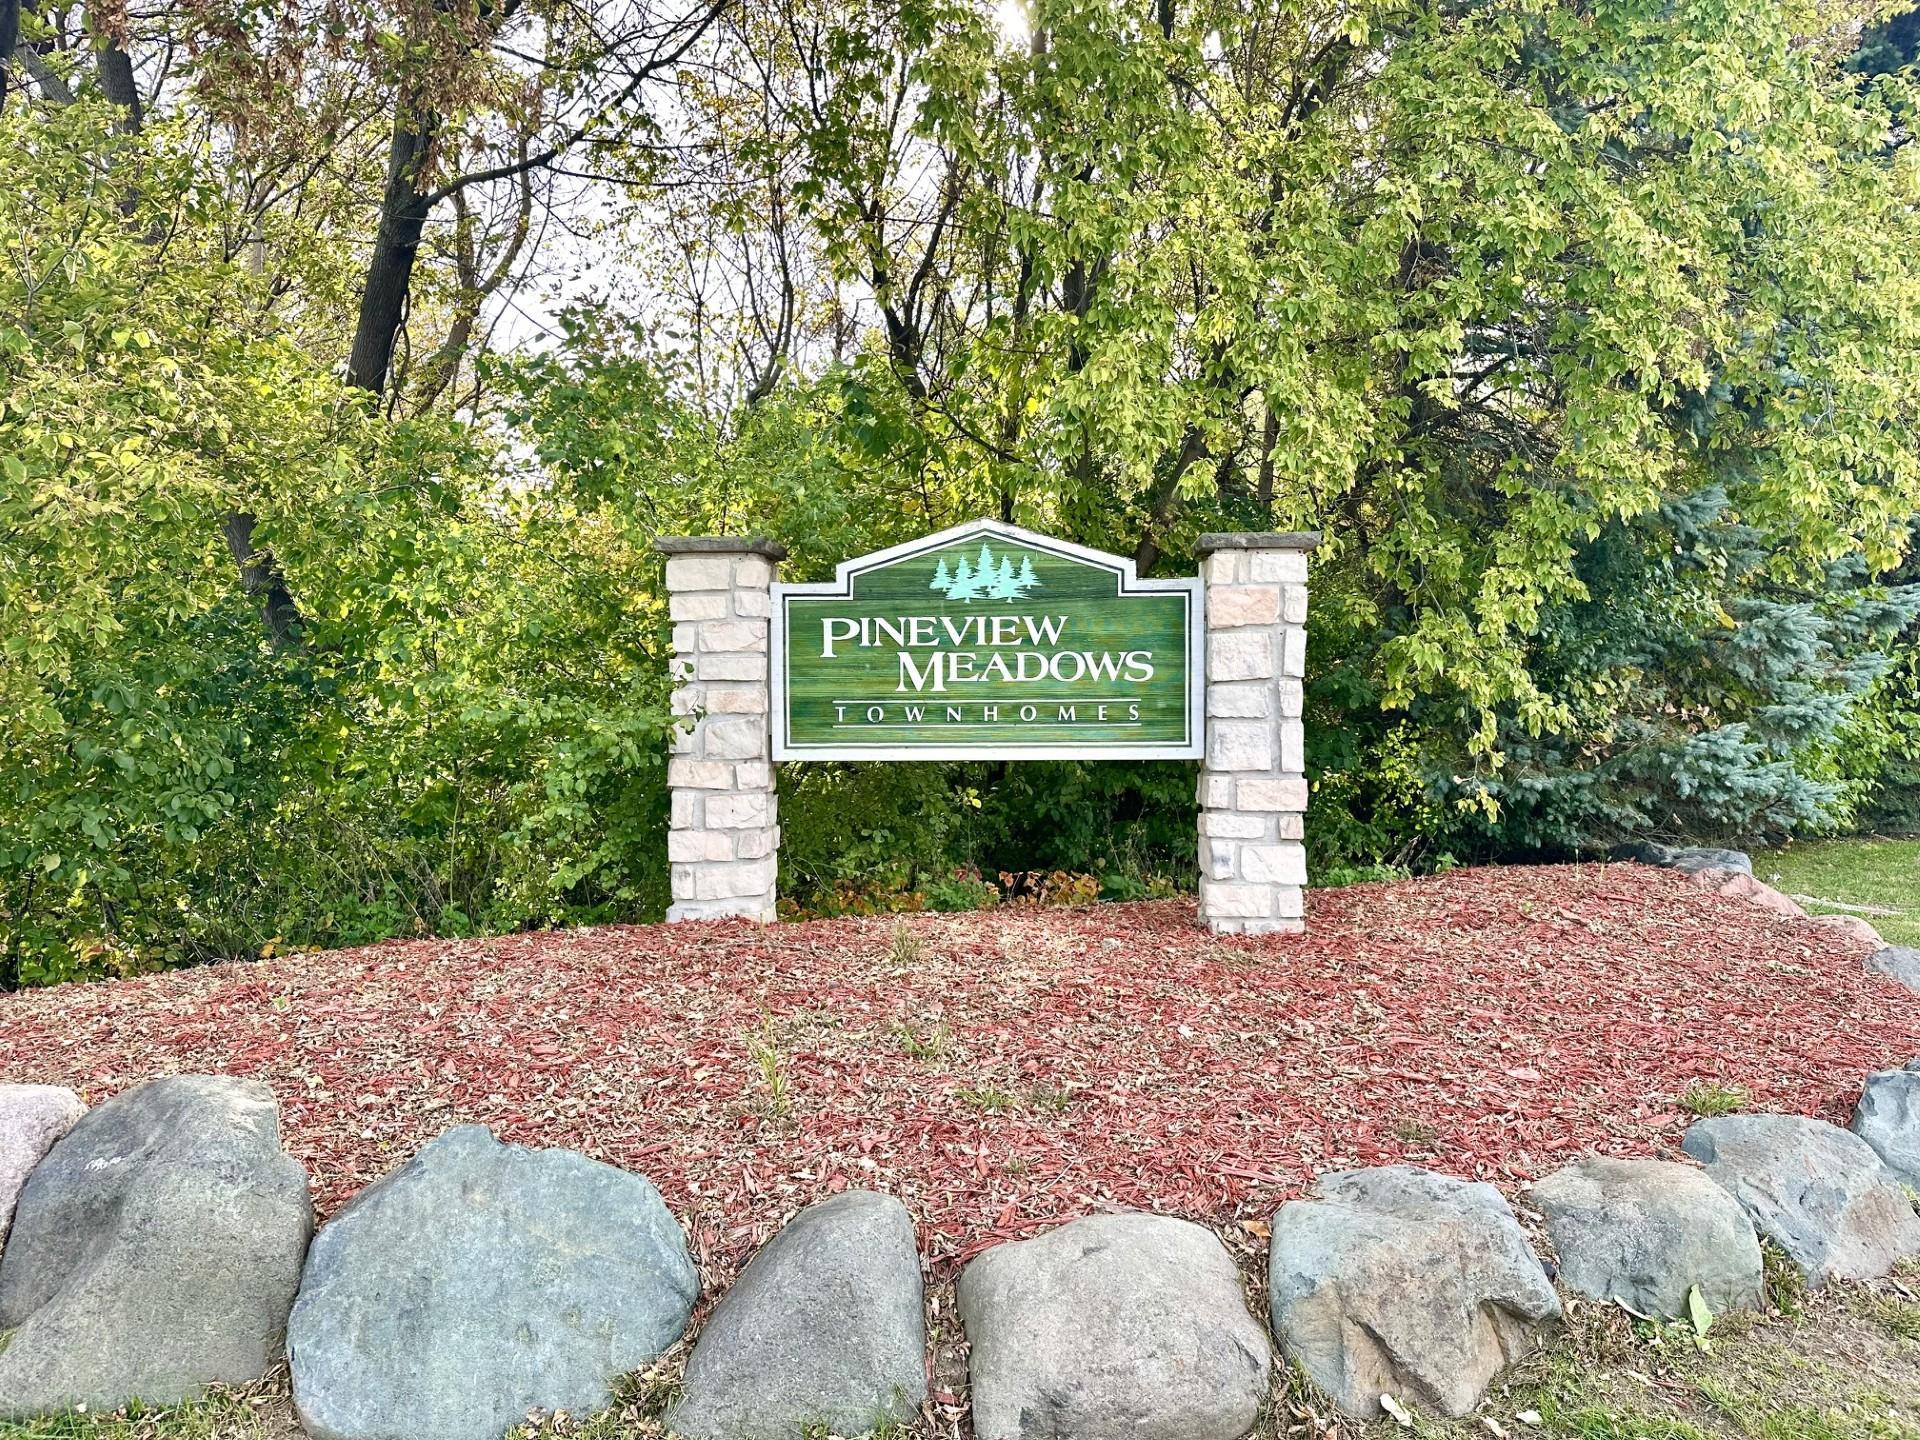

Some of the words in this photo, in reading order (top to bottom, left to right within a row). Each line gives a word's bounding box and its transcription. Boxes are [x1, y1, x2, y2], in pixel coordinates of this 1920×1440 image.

[819, 615, 1069, 658] PINEVIEW
[894, 650, 1155, 692] MEADOWS
[835, 704, 1139, 722] TOWNHOMES
